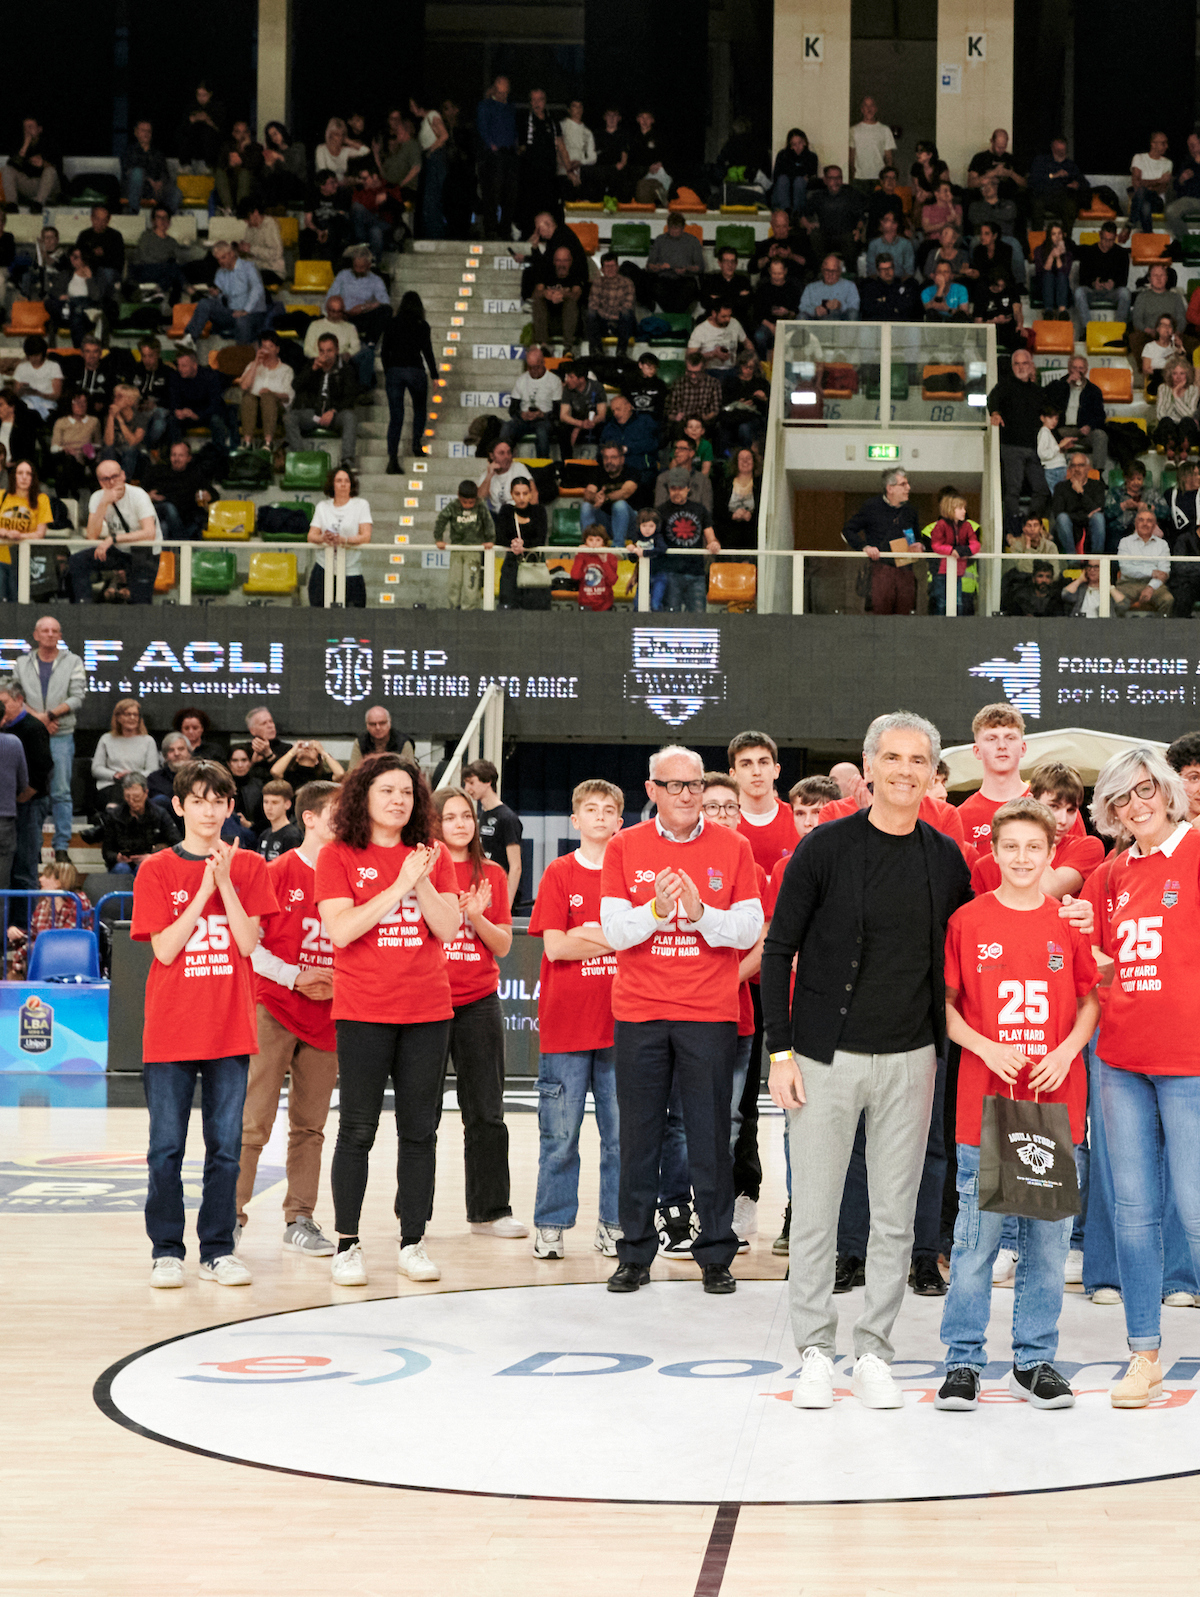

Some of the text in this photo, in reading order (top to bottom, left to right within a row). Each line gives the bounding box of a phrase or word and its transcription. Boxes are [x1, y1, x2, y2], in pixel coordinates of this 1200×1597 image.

[805, 37, 819, 57] K
[968, 36, 983, 56] K
[488, 302, 518, 314] FILA
[477, 346, 524, 359] FILA 7
[465, 394, 496, 406] FILA
[133, 640, 284, 674] ACLI
[383, 649, 448, 670] FIP
[1058, 657, 1188, 674] FONDAZIONE
[382, 674, 470, 697] TRENTINO
[185, 914, 230, 952] 25
[378, 926, 419, 936] PLAY HARD
[377, 937, 423, 947] STUDY HARD
[653, 935, 697, 945] PLAY HARD
[1116, 916, 1163, 963] 25
[443, 942, 461, 951] PLAY
[651, 946, 700, 957] STUDY HARD
[185, 953, 229, 966] PLAY HARD
[581, 955, 602, 966] PLAY
[184, 964, 233, 978] STUDY HARD
[581, 966, 606, 977] STUDY
[1135, 965, 1158, 977] HARD
[1137, 979, 1162, 991] HARD
[998, 980, 1049, 1024] 25
[24, 1018, 50, 1030] LBA
[999, 1029, 1045, 1041] PLAY HARD
[1027, 1043, 1047, 1056] HARD
